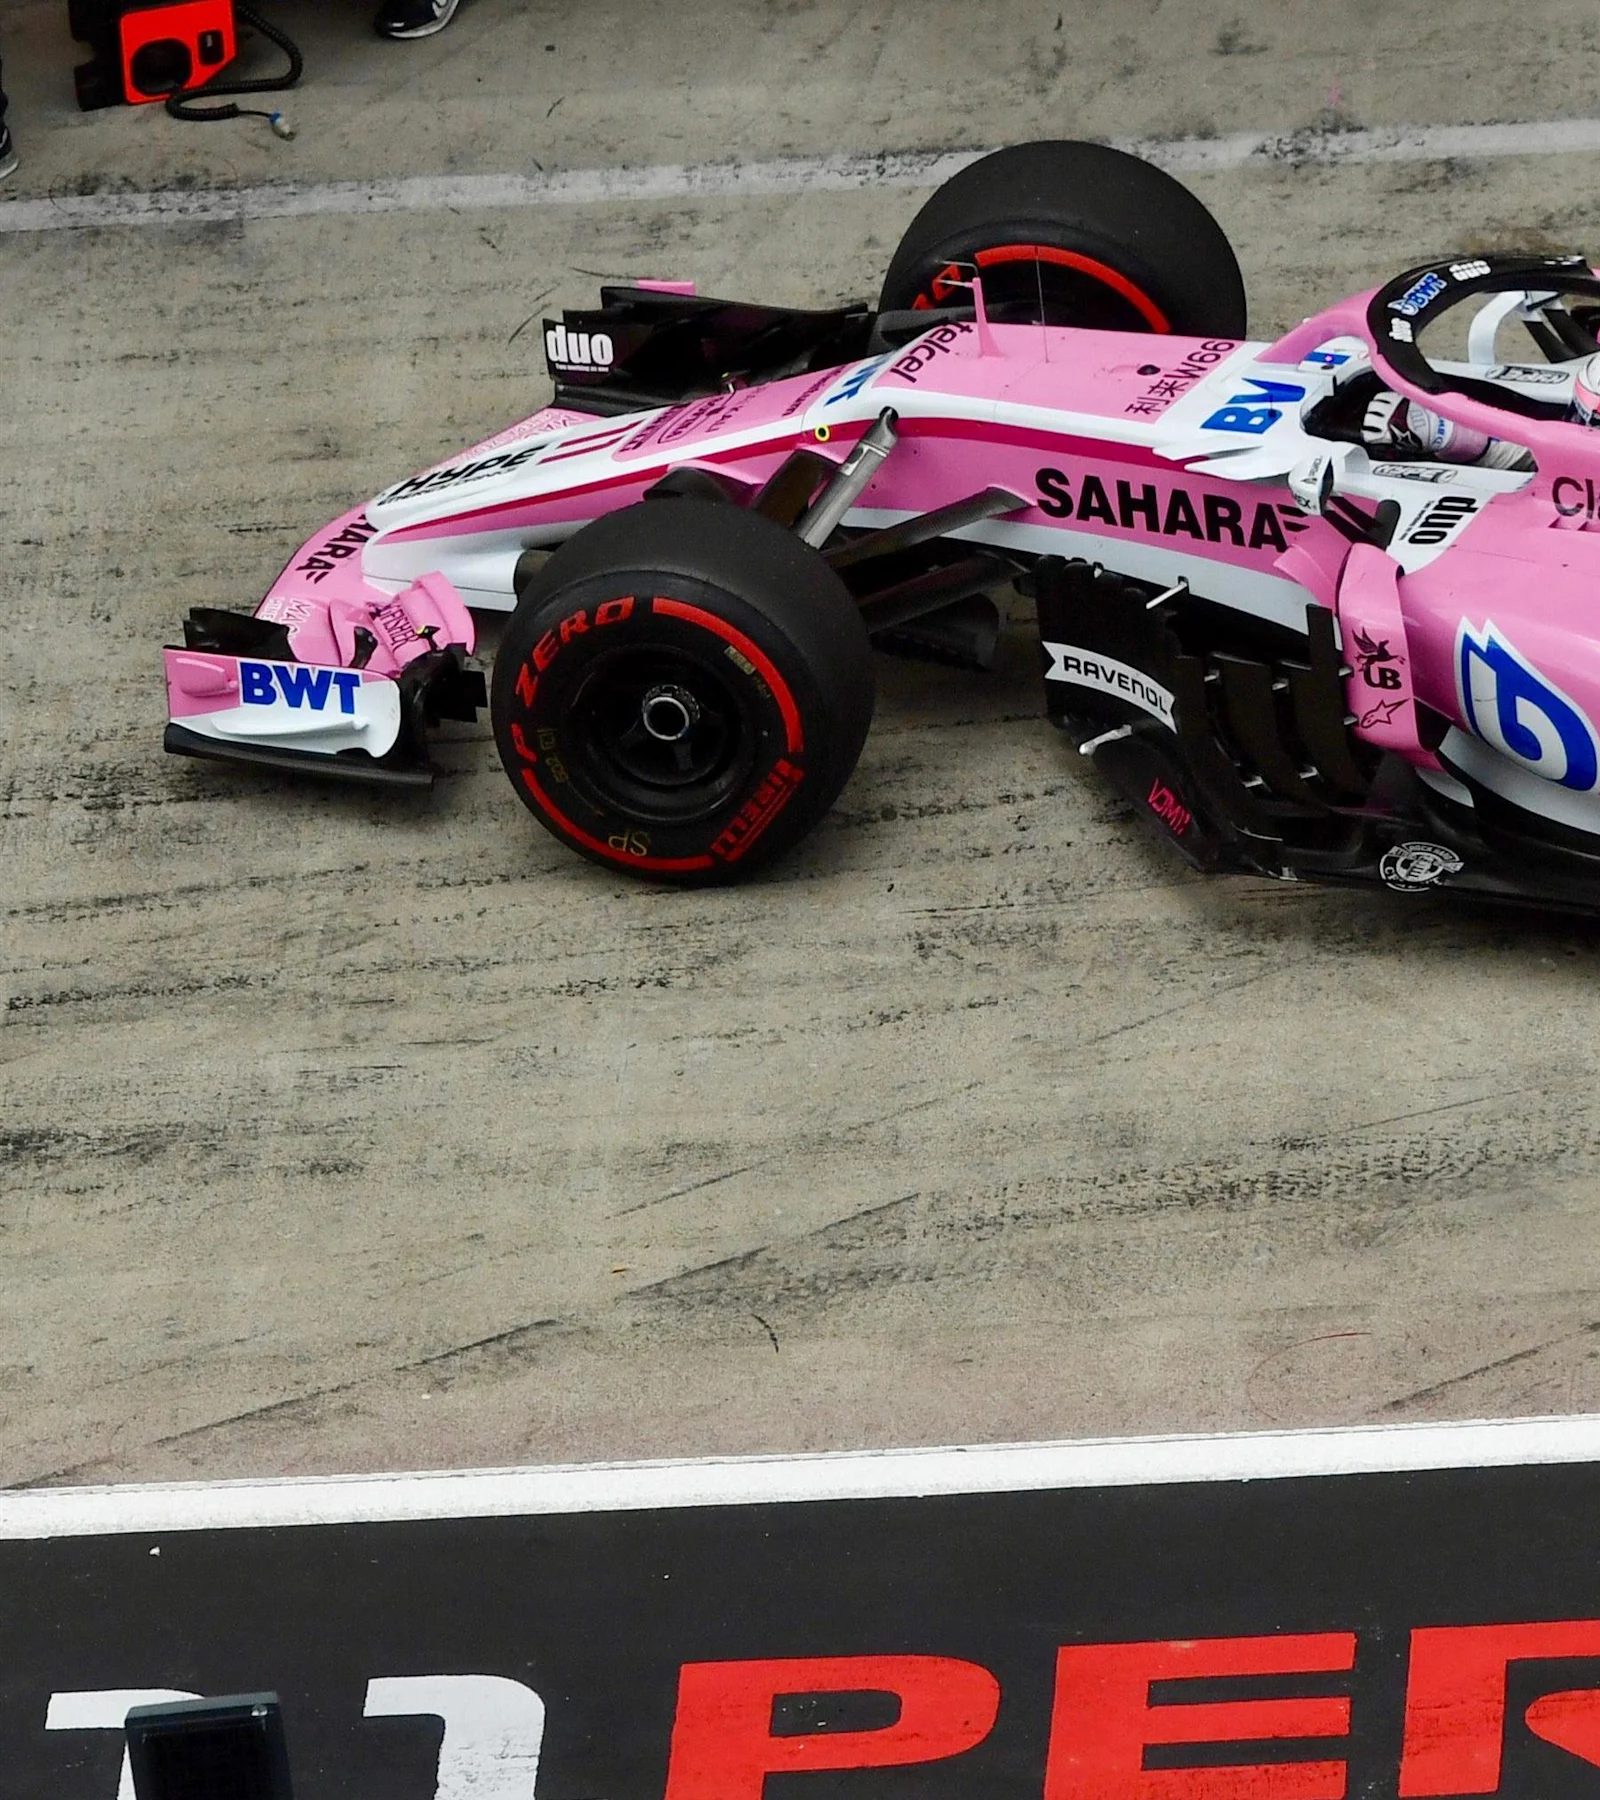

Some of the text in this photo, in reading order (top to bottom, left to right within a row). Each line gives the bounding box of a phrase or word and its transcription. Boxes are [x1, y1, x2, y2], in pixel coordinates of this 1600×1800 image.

[546, 324, 614, 366] duo
[890, 316, 974, 383] telcel
[1125, 338, 1236, 416] 利来W66
[388, 444, 548, 498] HYPE
[1035, 467, 1288, 553] SAHARA
[1408, 496, 1479, 545] duo
[240, 661, 361, 715] BWT
[511, 596, 635, 764] P ZERO
[1063, 656, 1168, 716] RAVENOL
[1363, 667, 1403, 690] UB
[608, 828, 652, 857] SP
